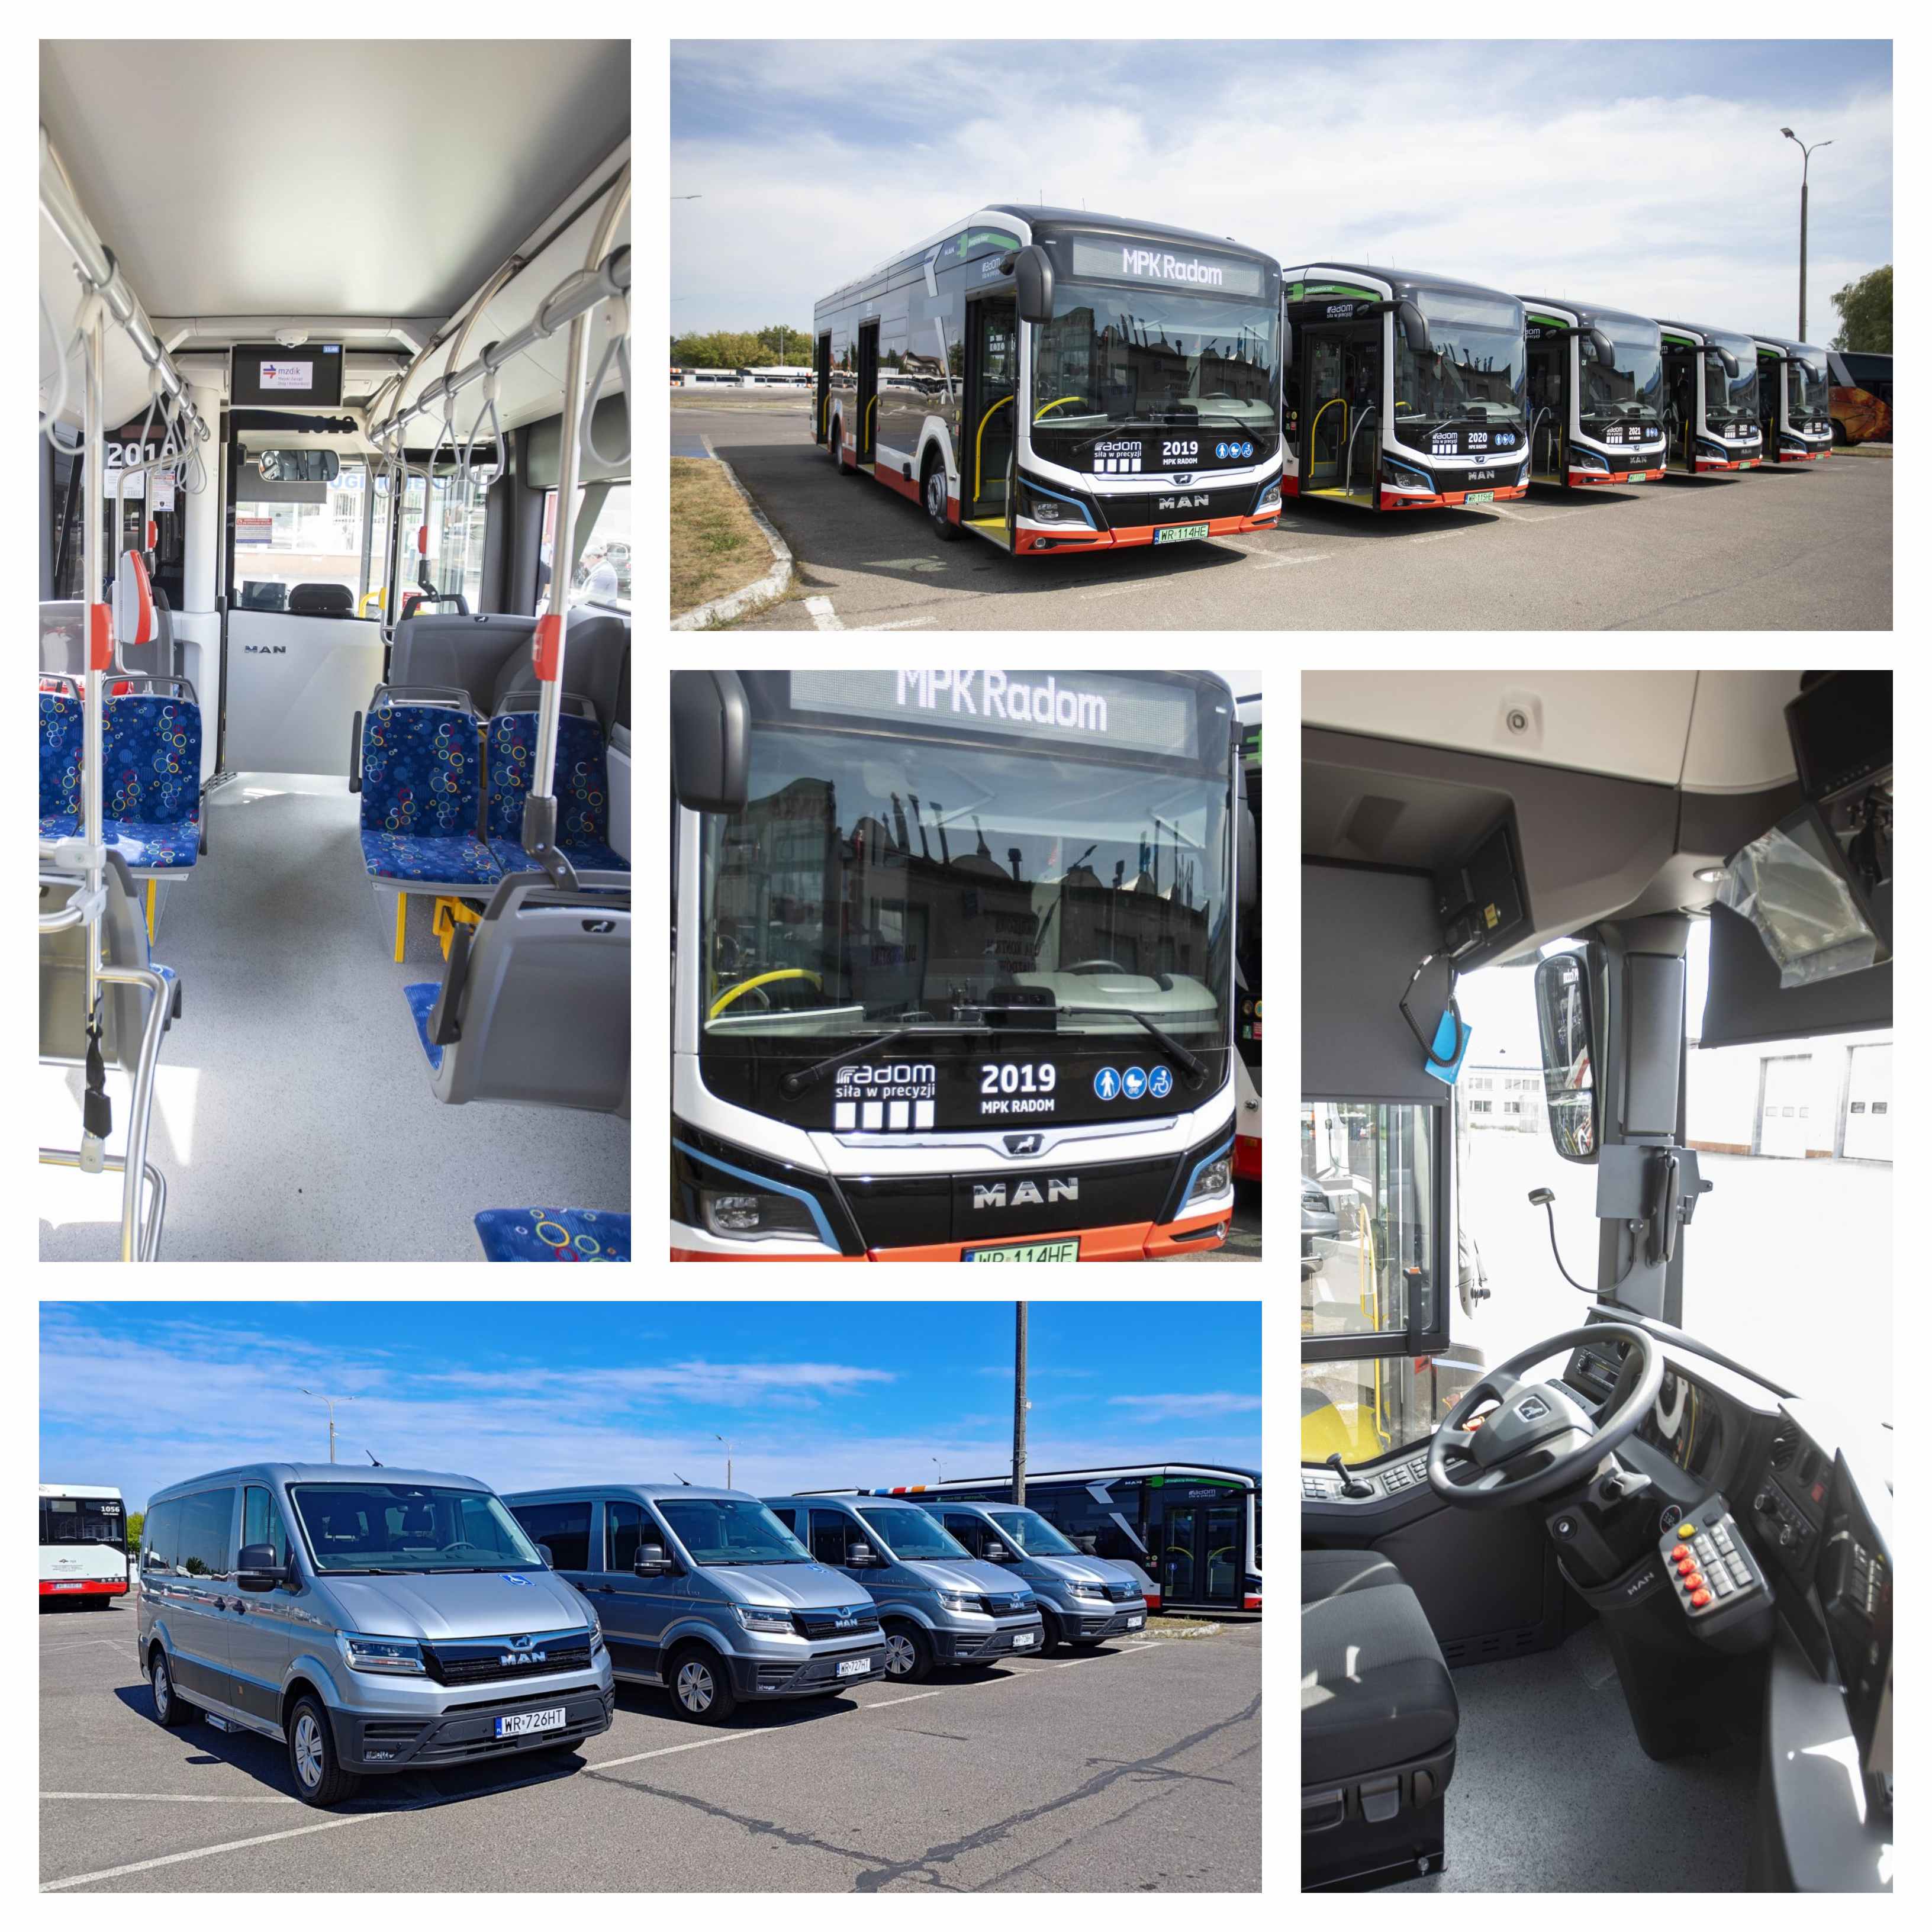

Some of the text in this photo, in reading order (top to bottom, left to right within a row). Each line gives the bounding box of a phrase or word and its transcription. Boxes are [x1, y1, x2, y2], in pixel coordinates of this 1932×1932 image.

[1123, 249, 1222, 285] MPK Radom
[1327, 304, 1353, 313] radom
[1469, 433, 1487, 443] 2020
[1094, 442, 1141, 450] radom
[1163, 442, 1198, 456] 2019
[1468, 471, 1495, 481] MAN
[1159, 495, 1209, 510] MAN
[1161, 526, 1206, 540] WR 114HE
[244, 645, 286, 653] MAN
[897, 670, 1107, 731] MPK Radom
[836, 1065, 935, 1084] radom
[981, 1064, 1056, 1094] 2019
[836, 1084, 935, 1099] siła w precyzji
[981, 1099, 1055, 1114] MPK RADOM
[973, 1177, 1078, 1209] MAN
[1627, 1572, 1655, 1595] MAN
[835, 1618, 858, 1629] MAN
[500, 1651, 546, 1666] MAN
[505, 1709, 563, 1732] WR 726HT
